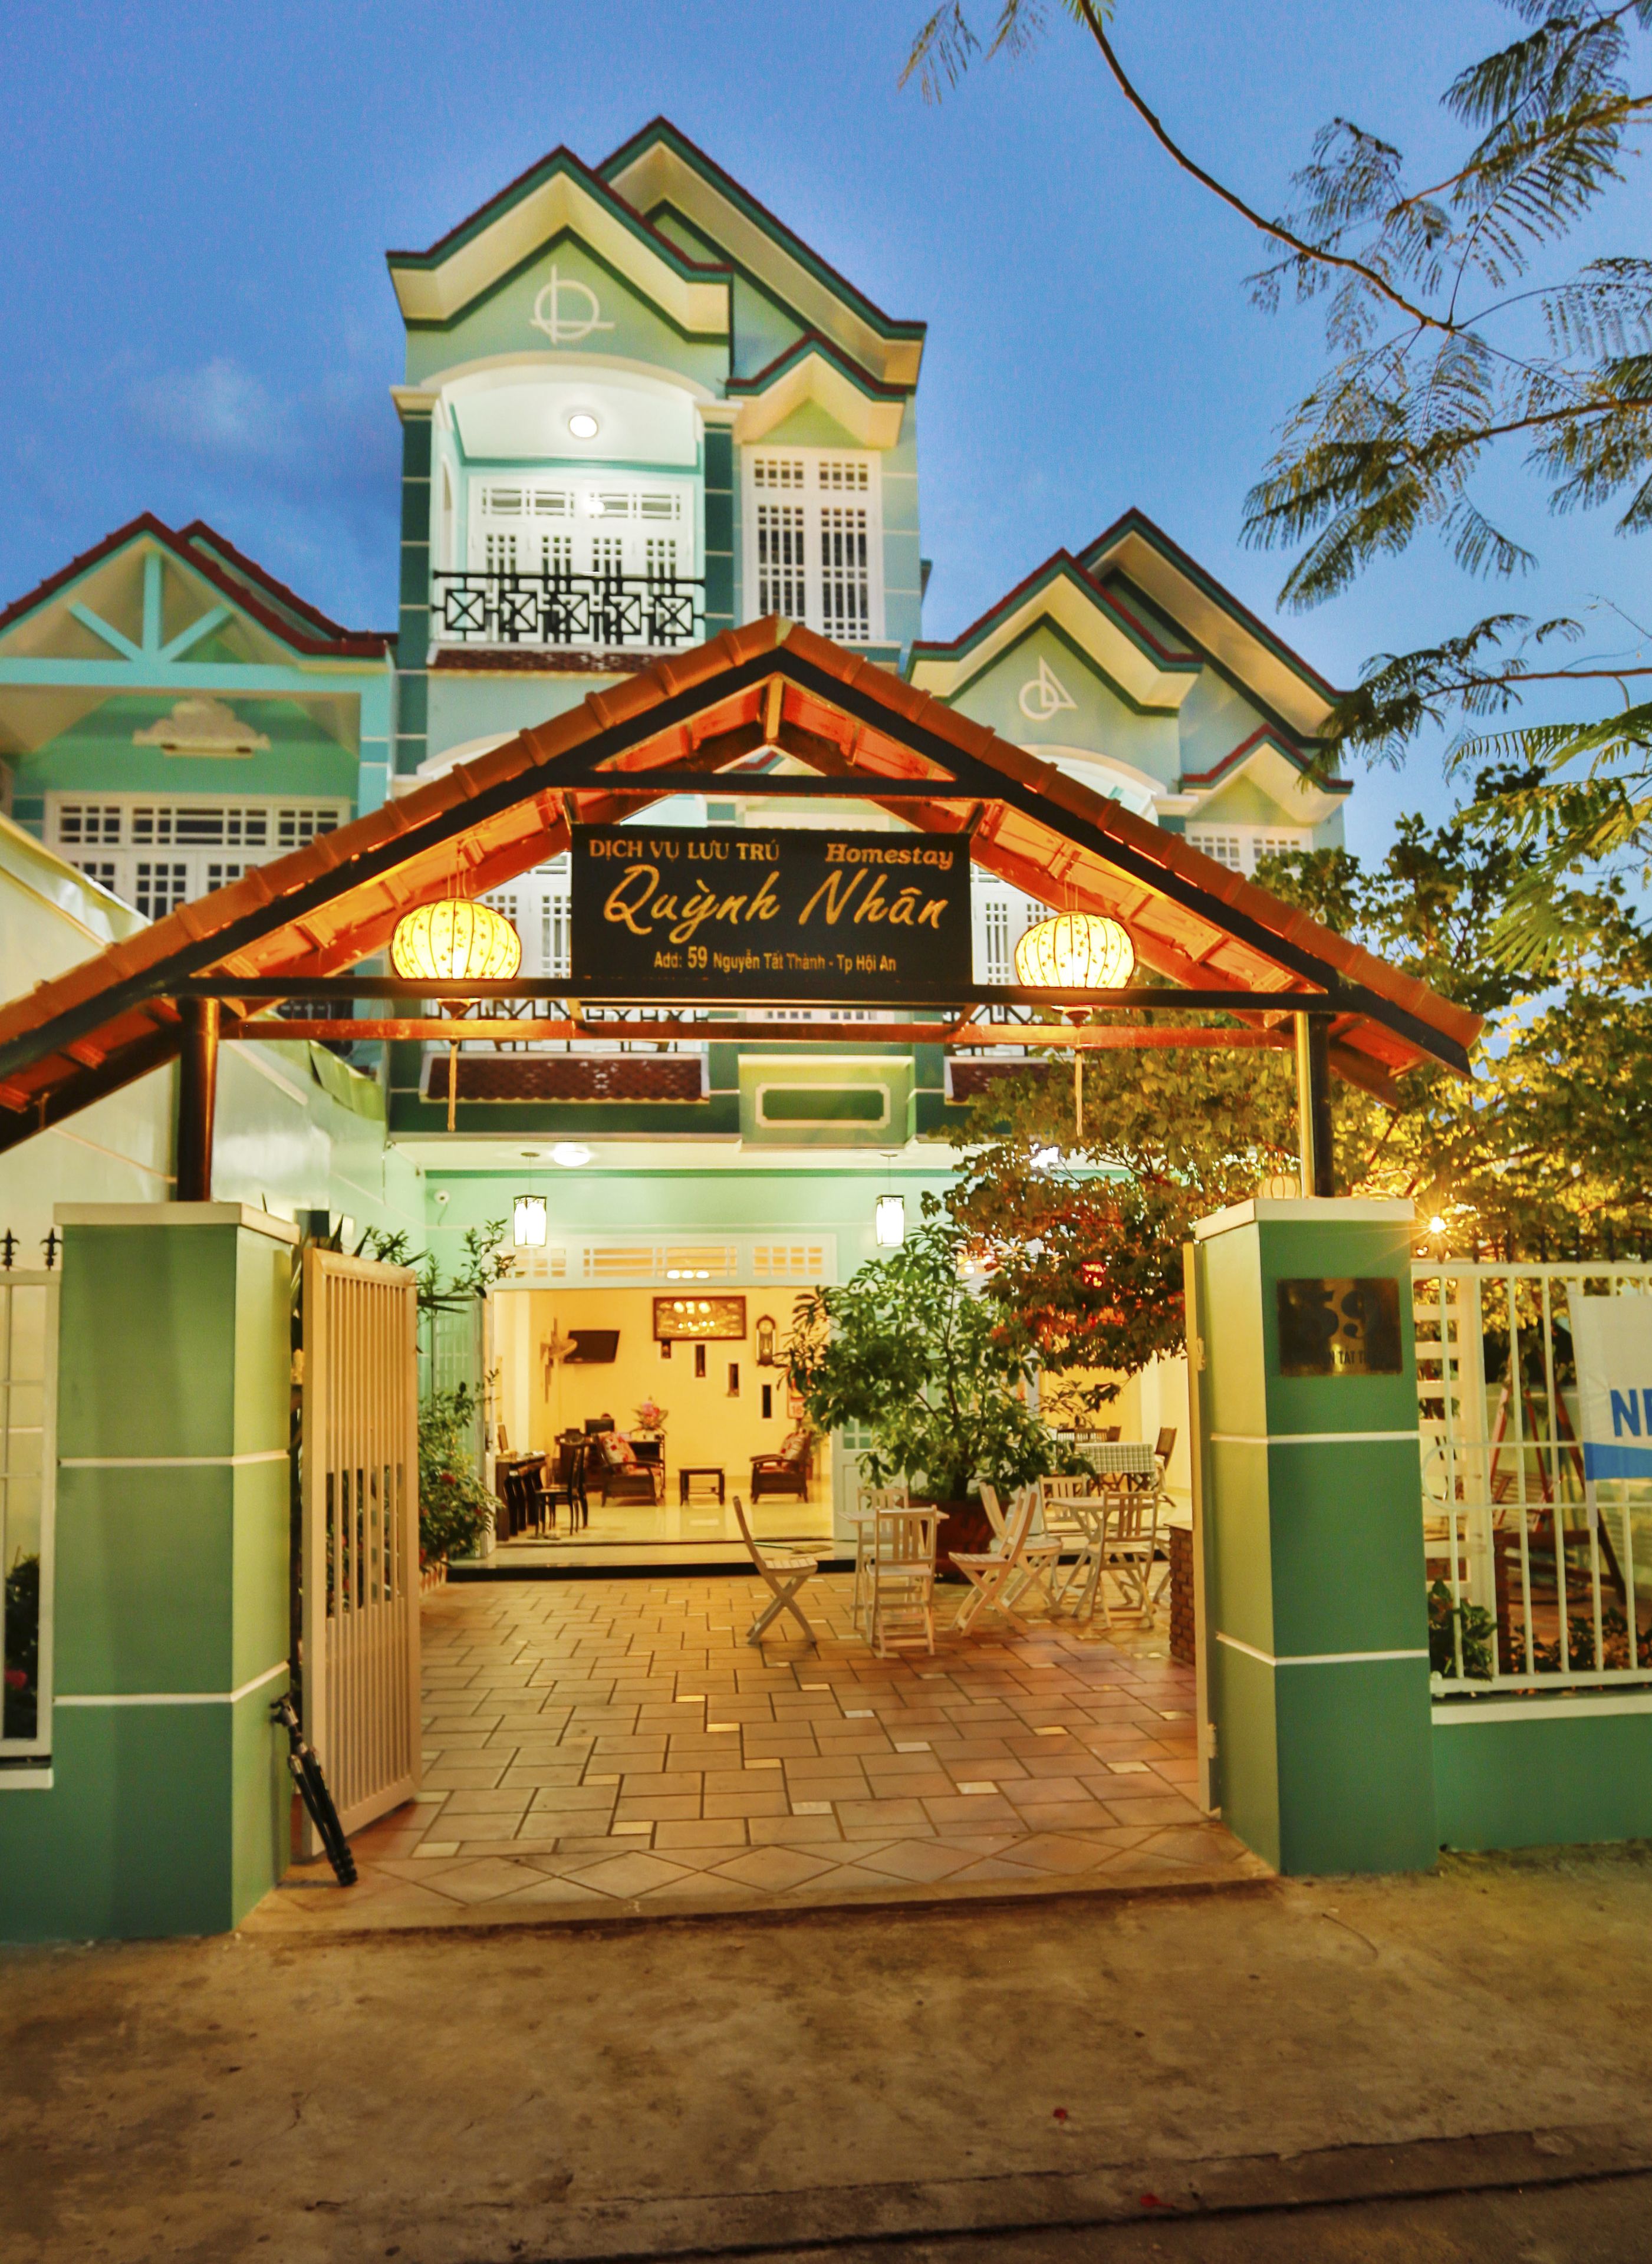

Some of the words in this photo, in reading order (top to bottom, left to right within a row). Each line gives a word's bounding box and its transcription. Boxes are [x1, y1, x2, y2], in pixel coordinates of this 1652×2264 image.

[590, 839, 643, 861] DỊCH
[650, 840, 680, 862] VỤ
[825, 843, 954, 870] Homestay
[604, 864, 780, 943] Quỳnh
[798, 868, 949, 929] Nhân
[653, 950, 683, 969] Add:
[687, 945, 708, 969] 59
[837, 953, 853, 974] Tp
[856, 953, 876, 973] Hội
[880, 954, 897, 971] An
